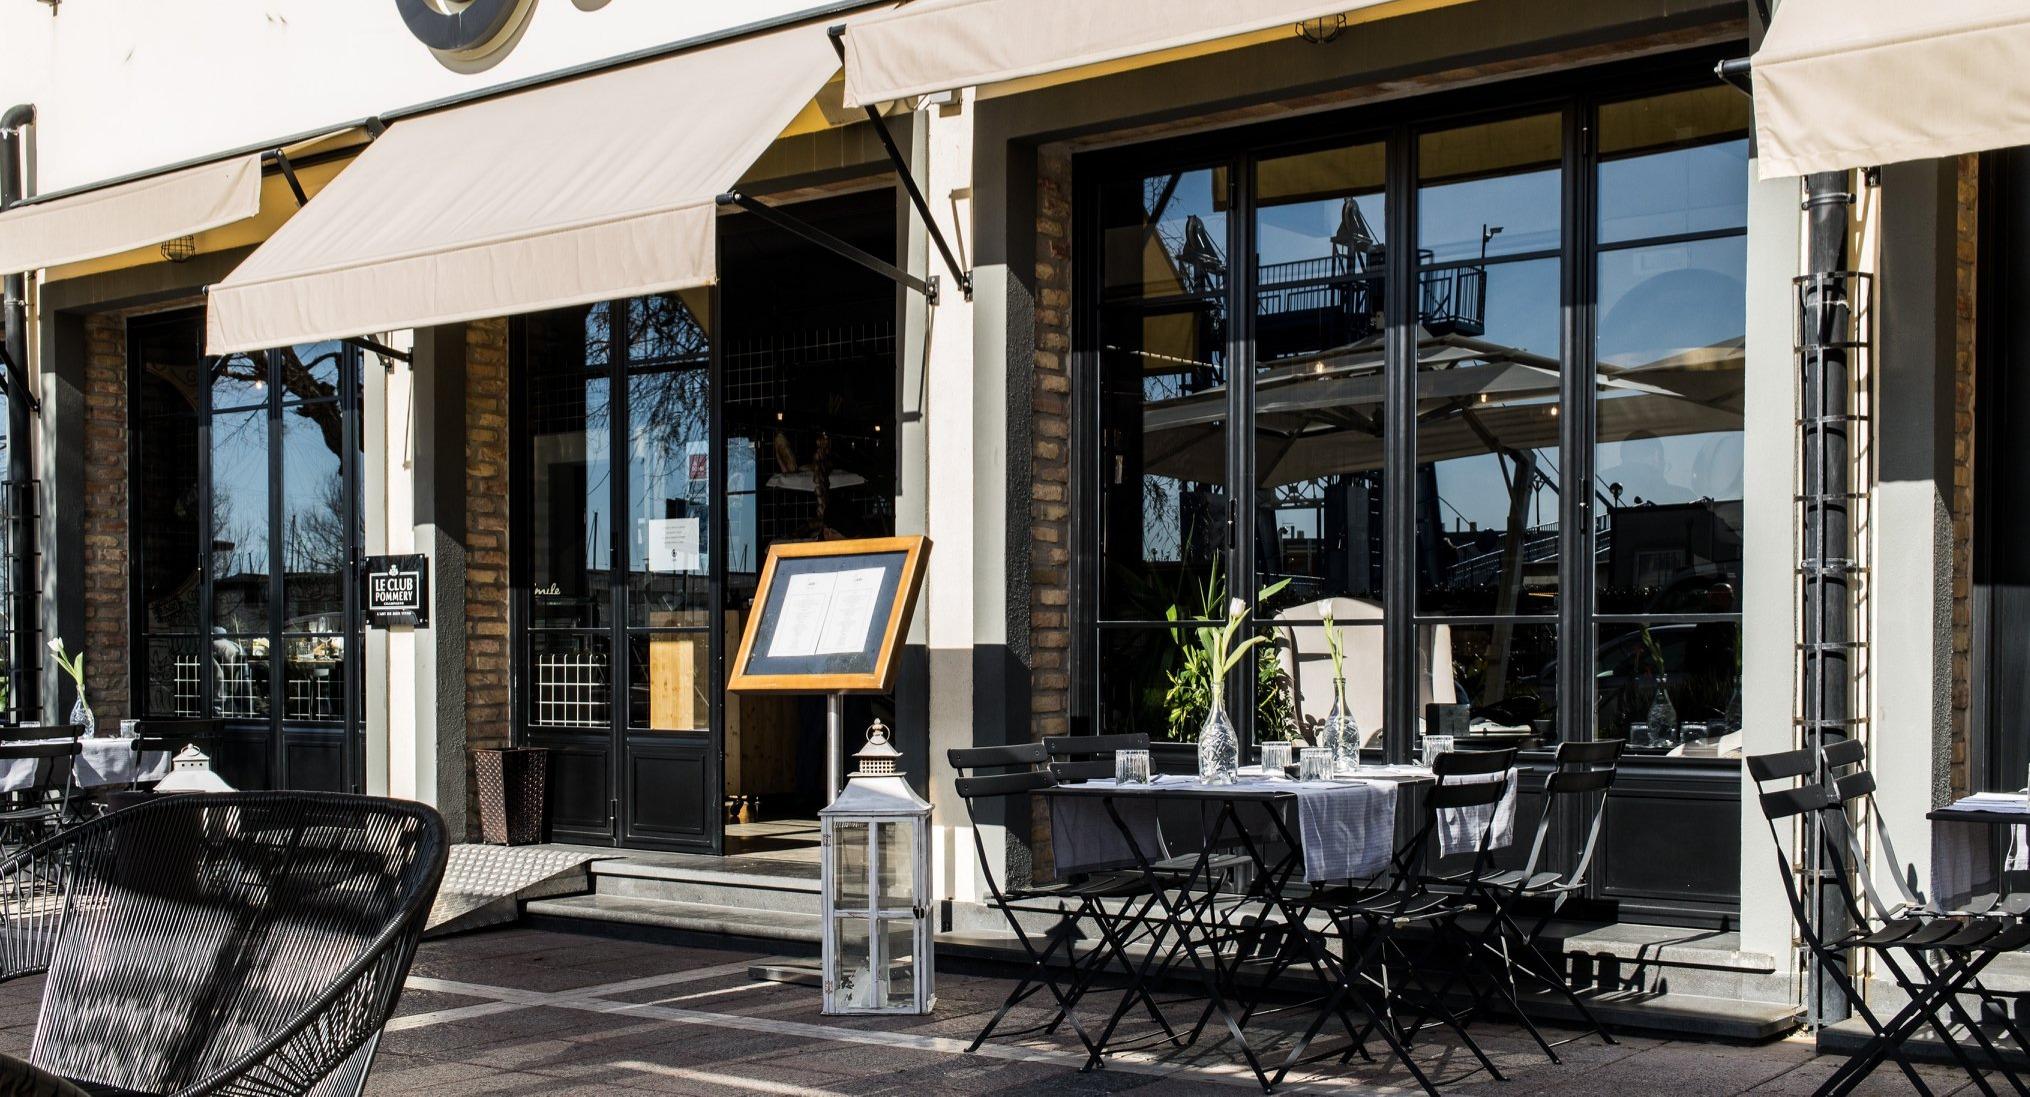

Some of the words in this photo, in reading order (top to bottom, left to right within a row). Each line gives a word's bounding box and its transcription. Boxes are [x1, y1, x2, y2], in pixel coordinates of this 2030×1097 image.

[375, 579, 386, 592] LE
[387, 578, 413, 591] CLUB
[375, 591, 413, 602] POMMERY
